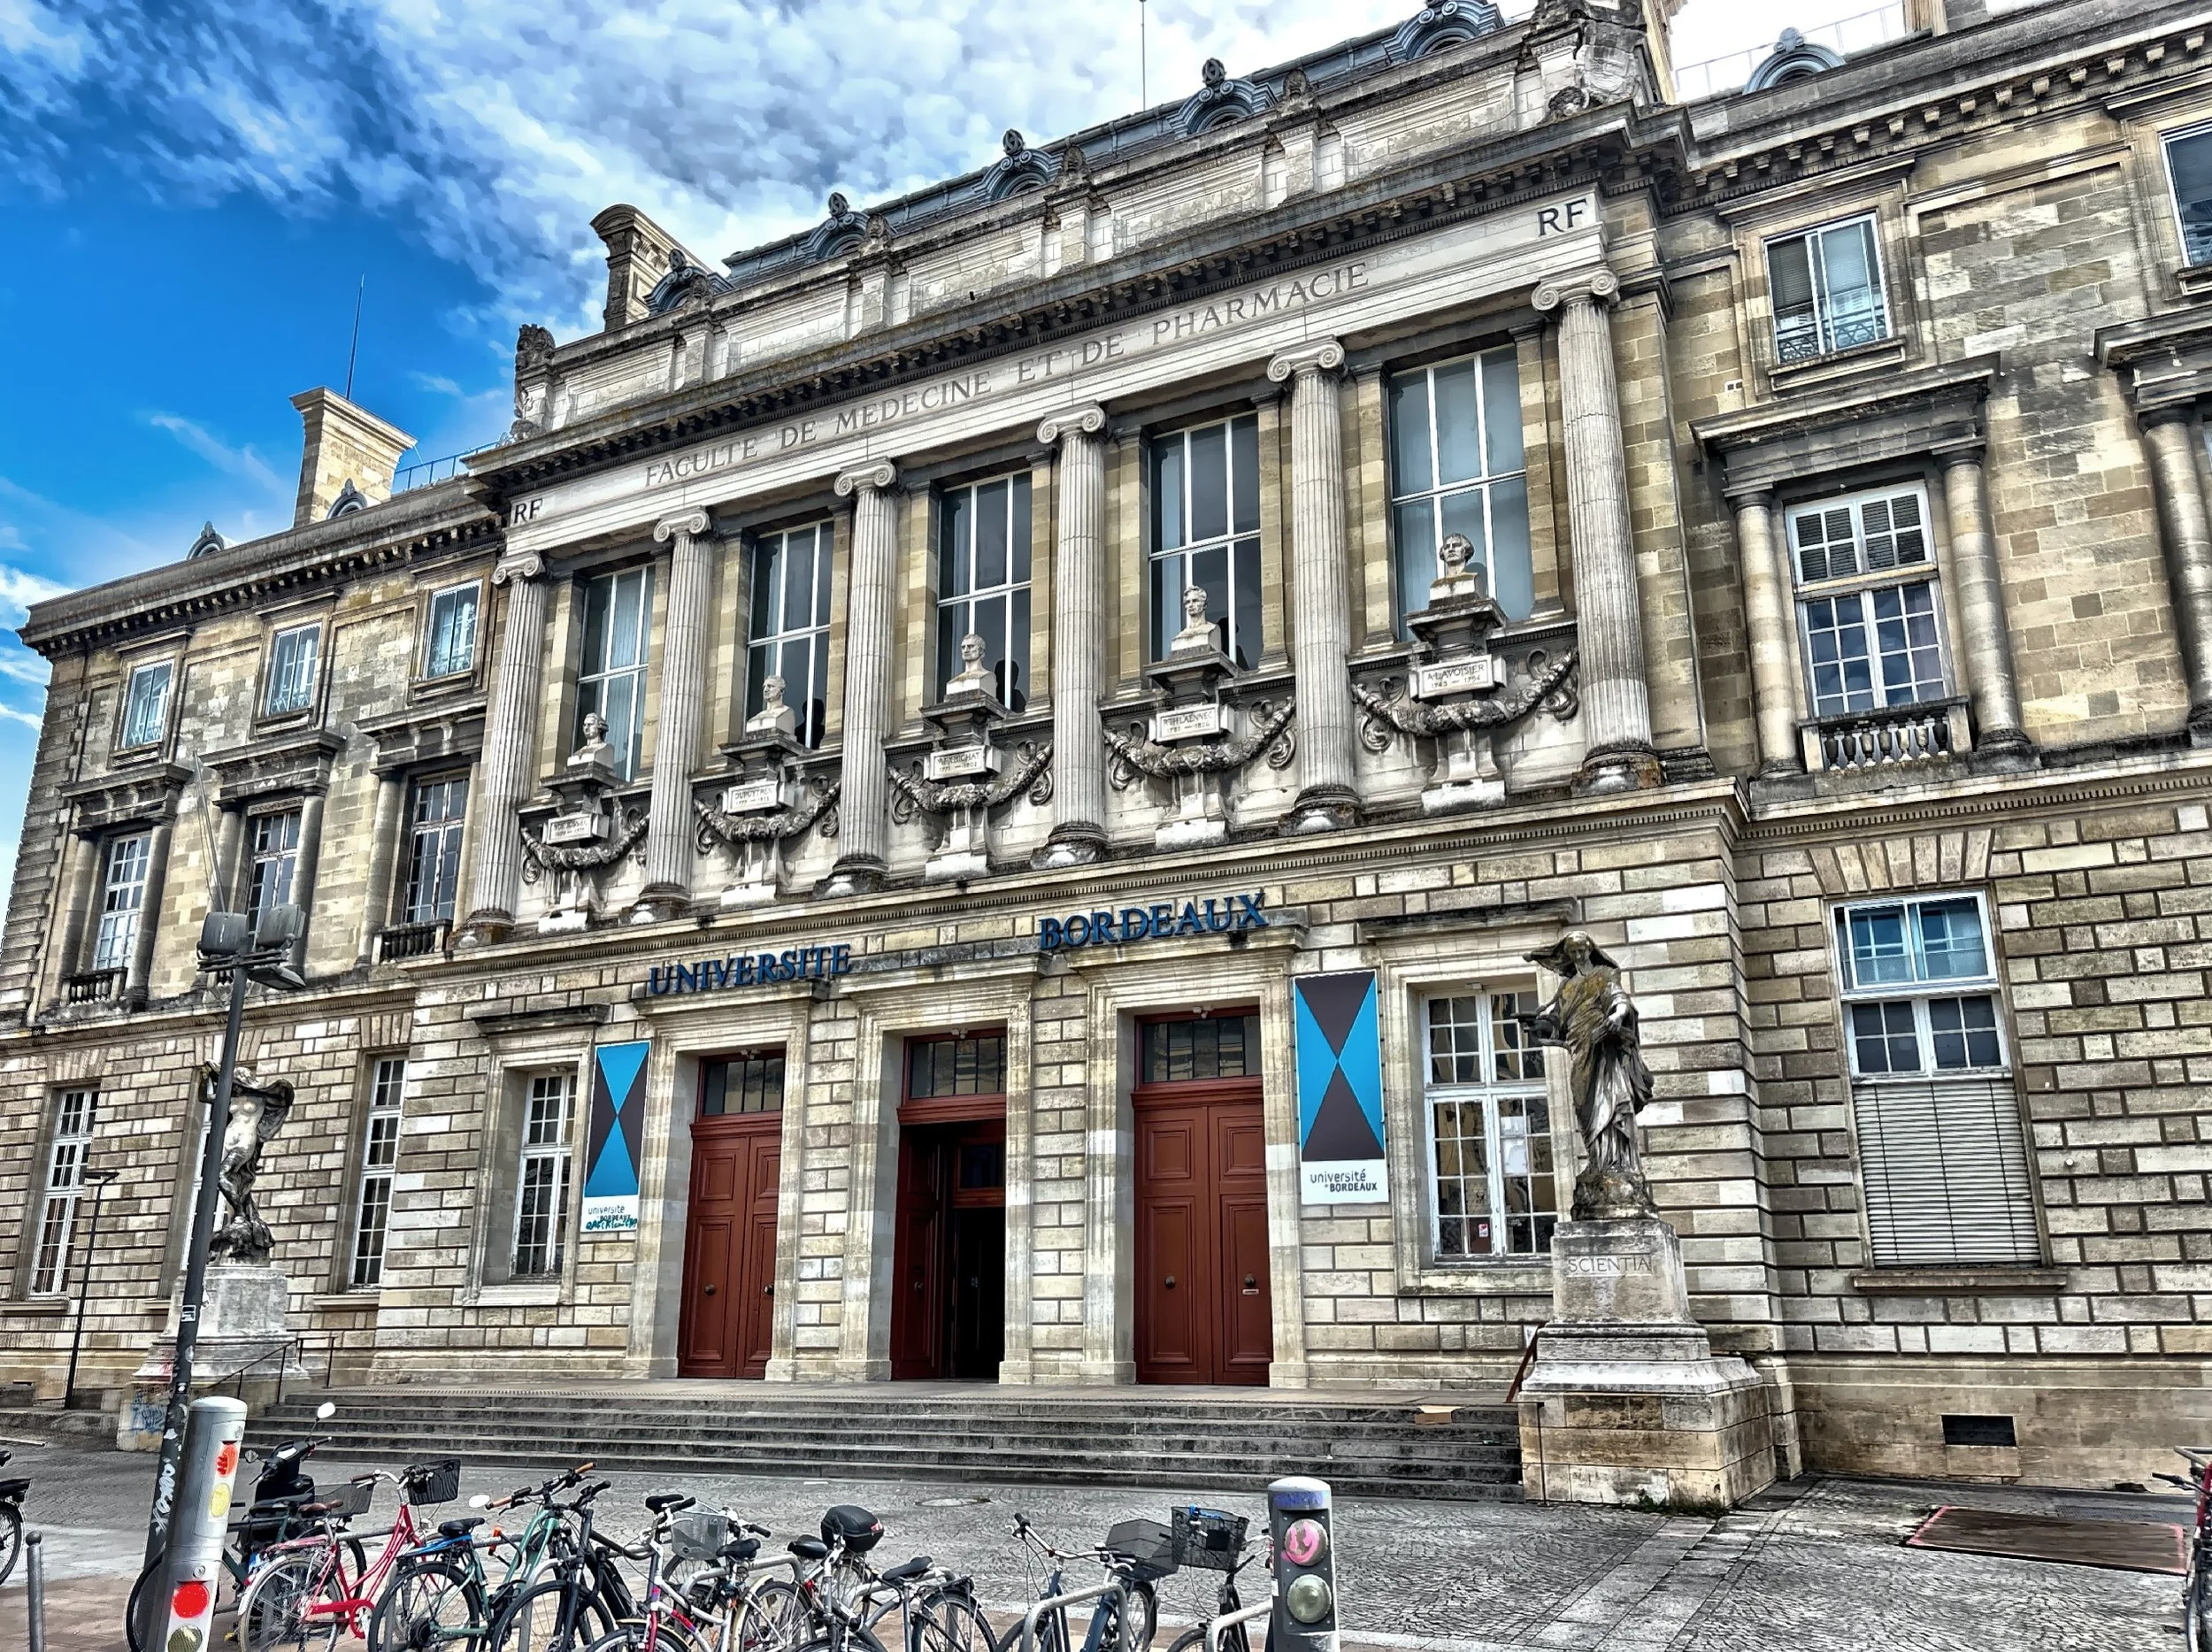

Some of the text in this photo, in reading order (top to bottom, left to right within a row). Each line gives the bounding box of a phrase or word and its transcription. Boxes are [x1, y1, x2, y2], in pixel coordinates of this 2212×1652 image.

[1537, 198, 1587, 237] RF
[645, 262, 1369, 487] FACULTE DE MEDECINE ET DE PHARMACIE
[514, 498, 542, 524] RF
[648, 893, 1270, 995] UNIVERSITE BORDEAUX
[1310, 1168, 1366, 1184] université
[1330, 1182, 1378, 1192] BORDEAUX
[1568, 1256, 1652, 1272] SCIENTIA
